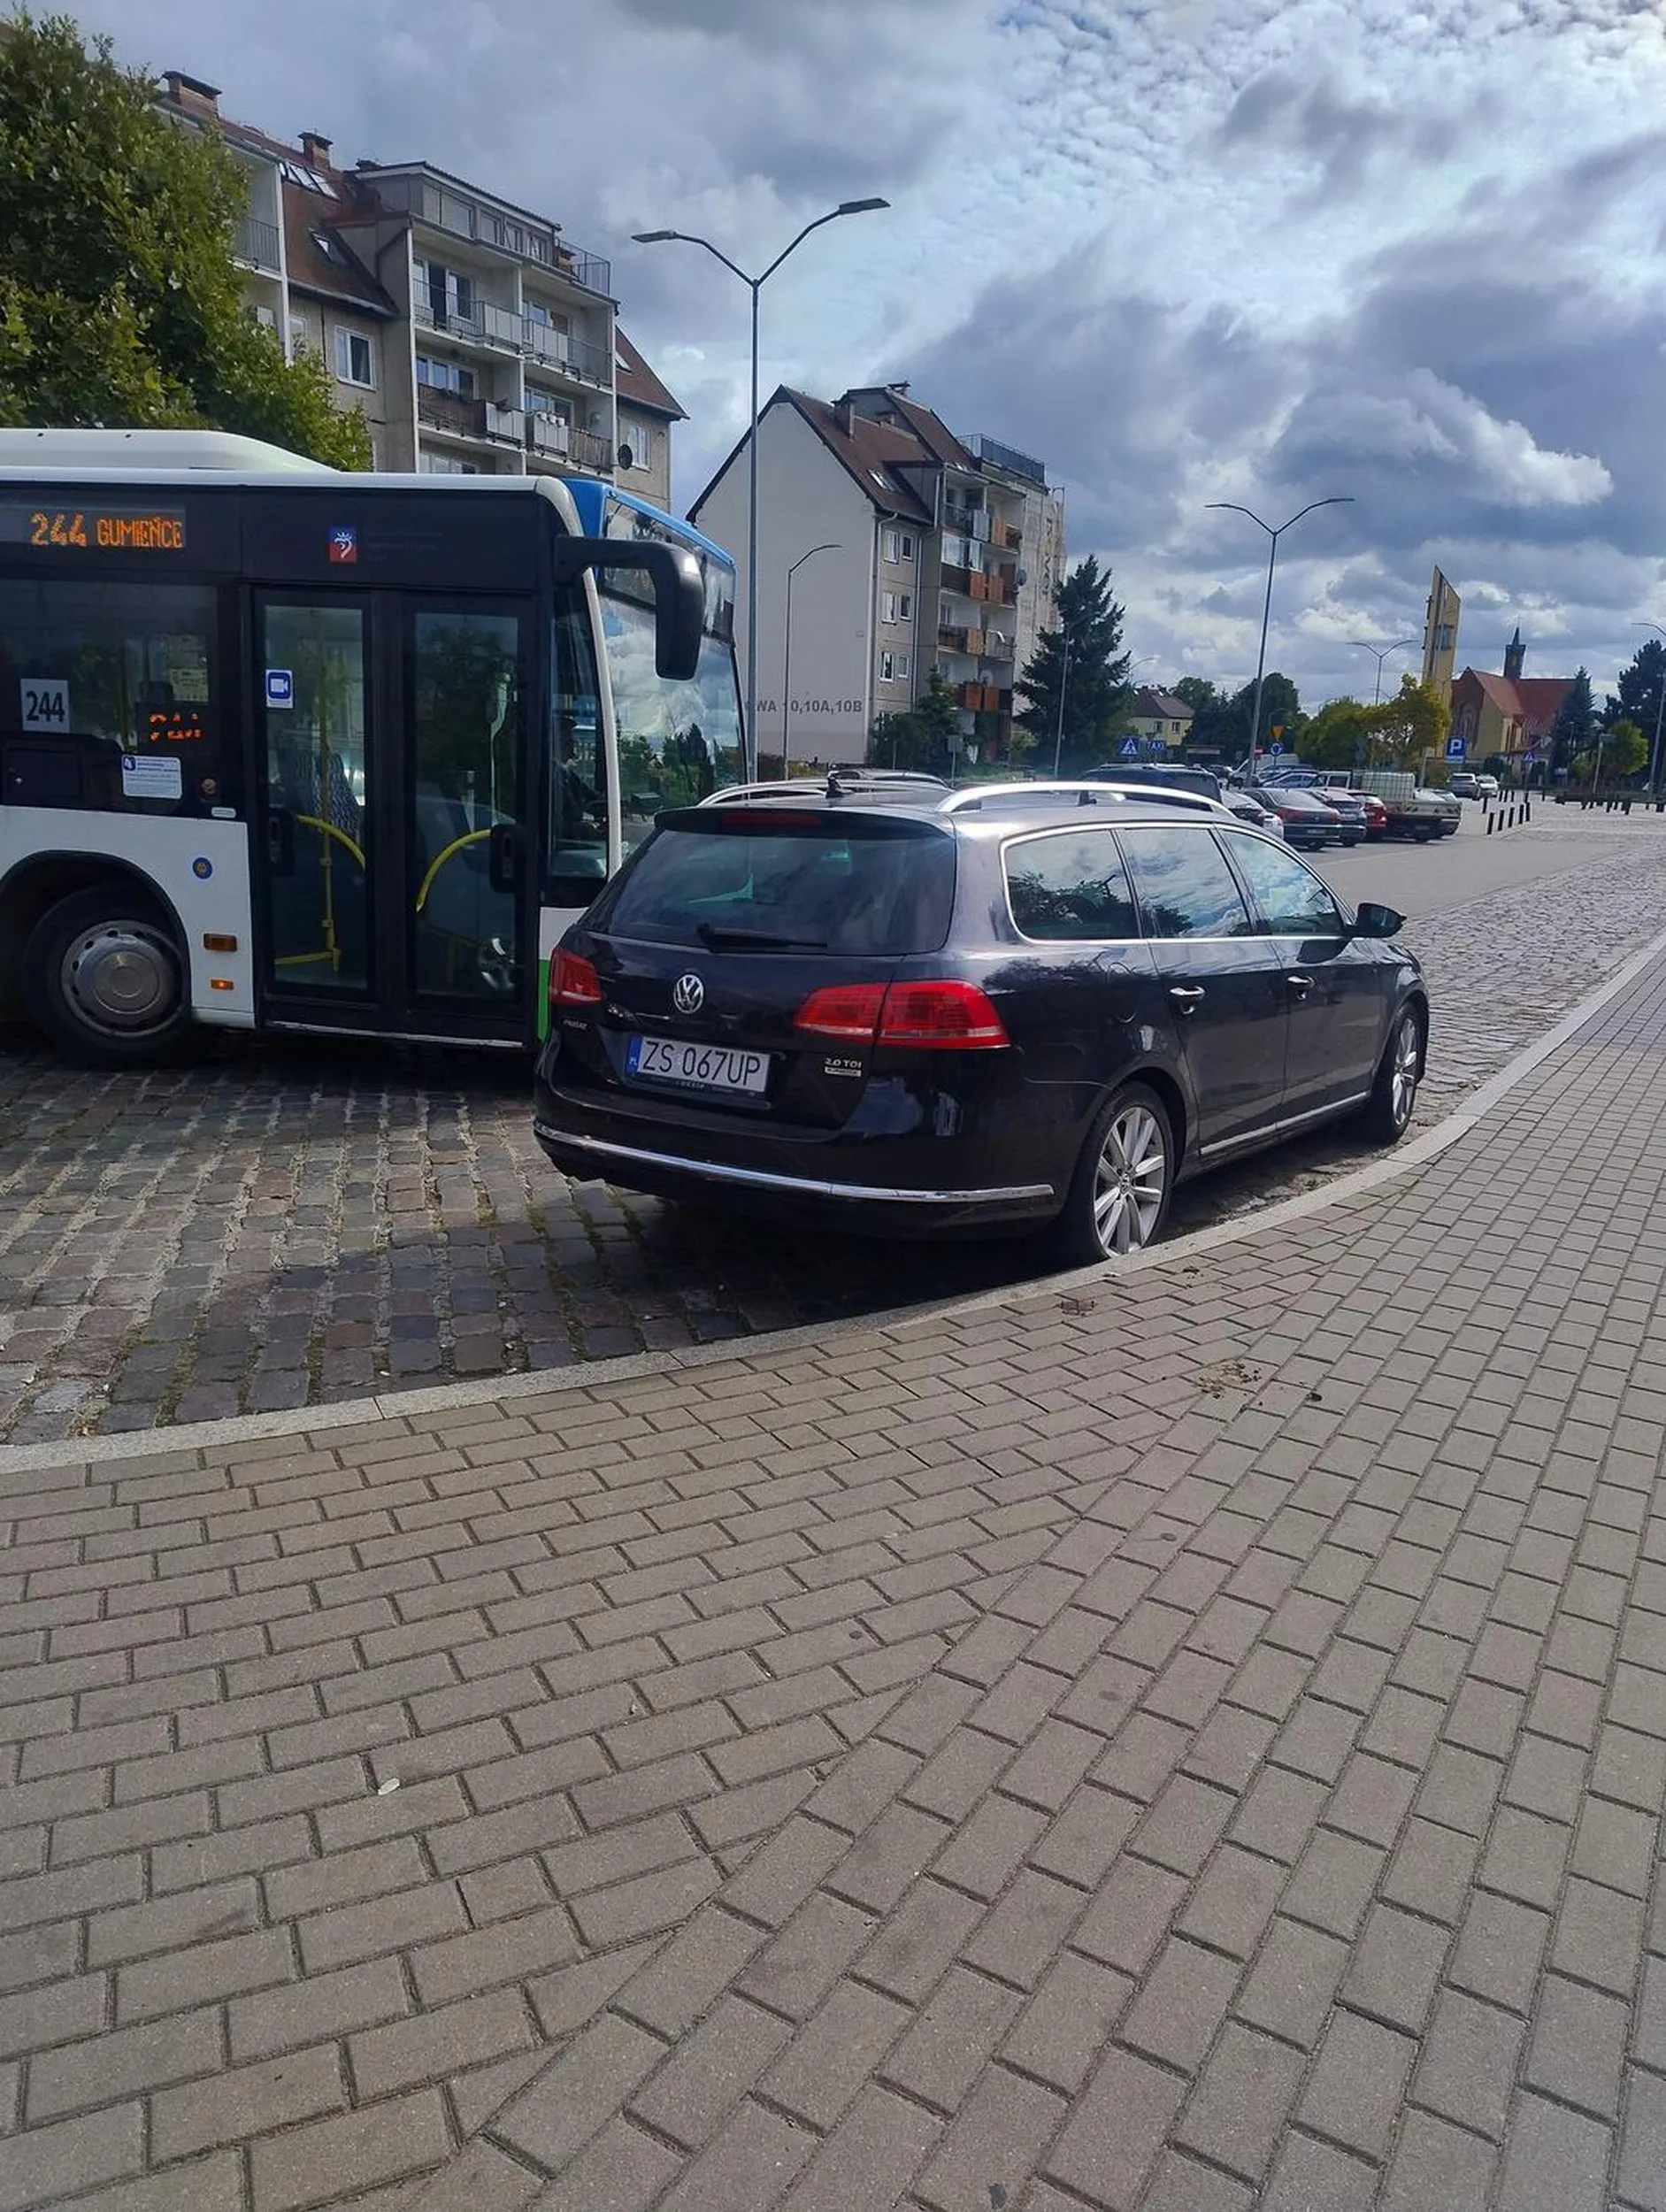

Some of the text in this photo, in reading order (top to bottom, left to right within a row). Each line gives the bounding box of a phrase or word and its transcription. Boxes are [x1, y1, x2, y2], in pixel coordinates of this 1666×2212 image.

[30, 513, 87, 546] 244
[26, 691, 65, 722] 244
[1450, 739, 1462, 753] P
[643, 1041, 674, 1072] ZS
[682, 1048, 761, 1087] 067UP
[842, 1059, 862, 1068] TDI
